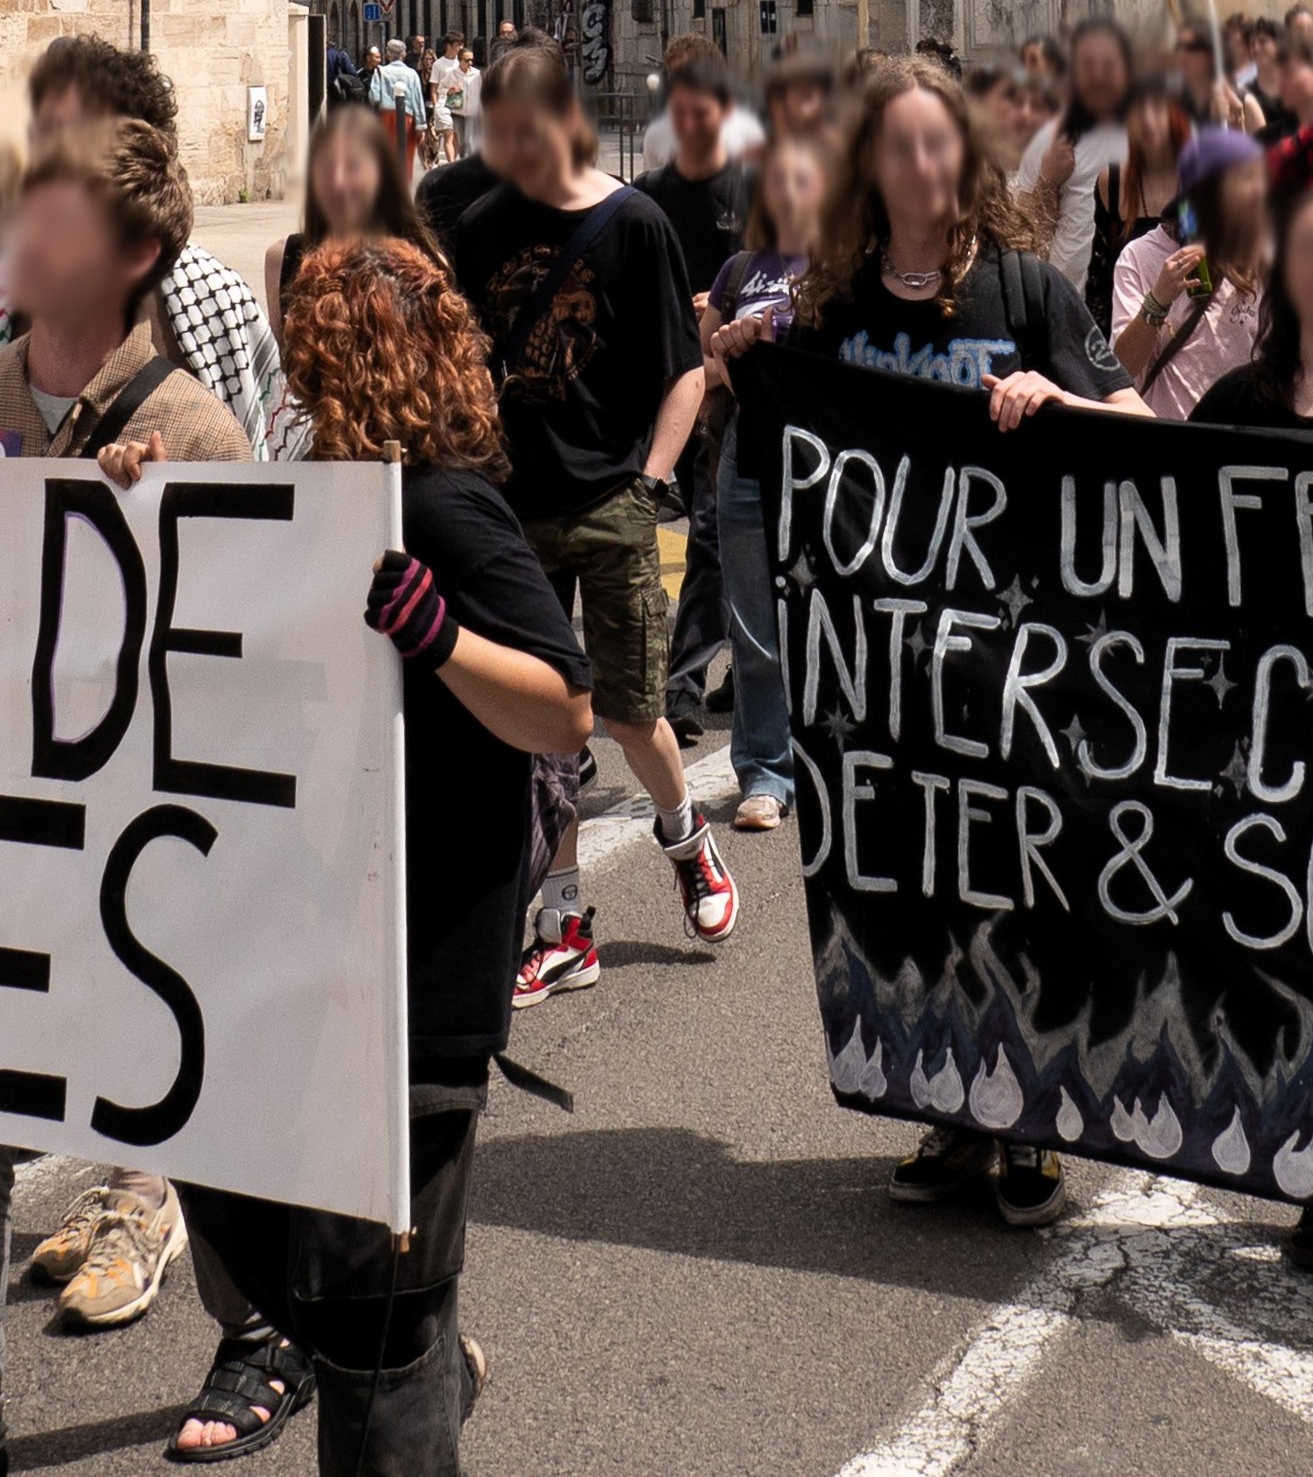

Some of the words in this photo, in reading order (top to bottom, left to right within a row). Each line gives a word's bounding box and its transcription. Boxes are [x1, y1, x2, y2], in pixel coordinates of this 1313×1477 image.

[778, 423, 1008, 591] POUR
[1060, 475, 1181, 604] UN
[33, 477, 296, 808] DE
[791, 738, 1070, 914] DETER
[1098, 798, 1194, 926] &
